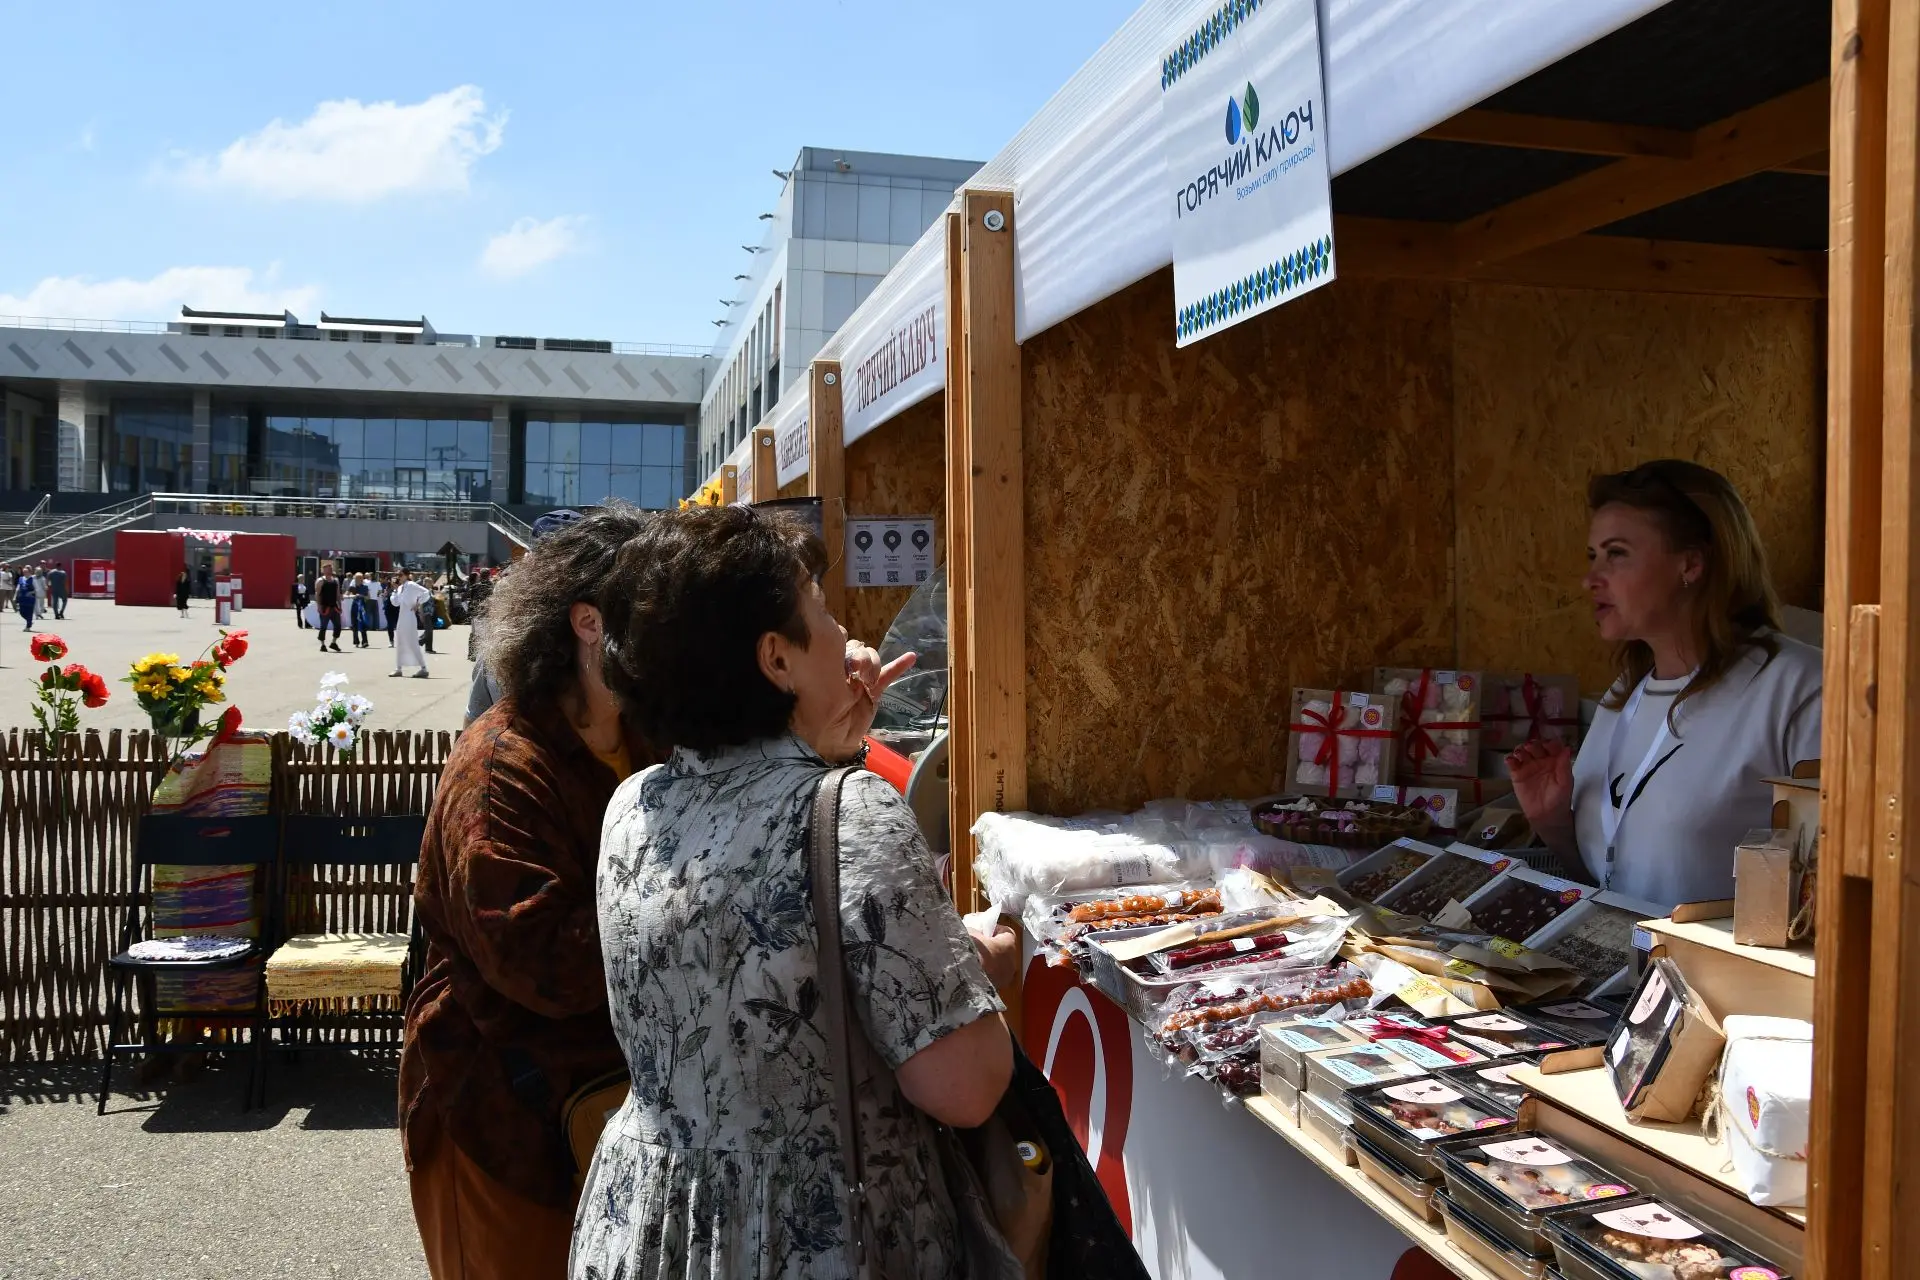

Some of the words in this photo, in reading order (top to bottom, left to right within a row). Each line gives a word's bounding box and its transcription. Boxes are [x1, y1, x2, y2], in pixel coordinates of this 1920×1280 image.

[1177, 137, 1252, 219] ГОРЯЧИЙ
[1256, 100, 1314, 168] КЛЮЧ
[1262, 166, 1279, 185] силу
[857, 329, 897, 412] ГОРЯЧИЙ
[899, 305, 936, 383] КЛЮЧ
